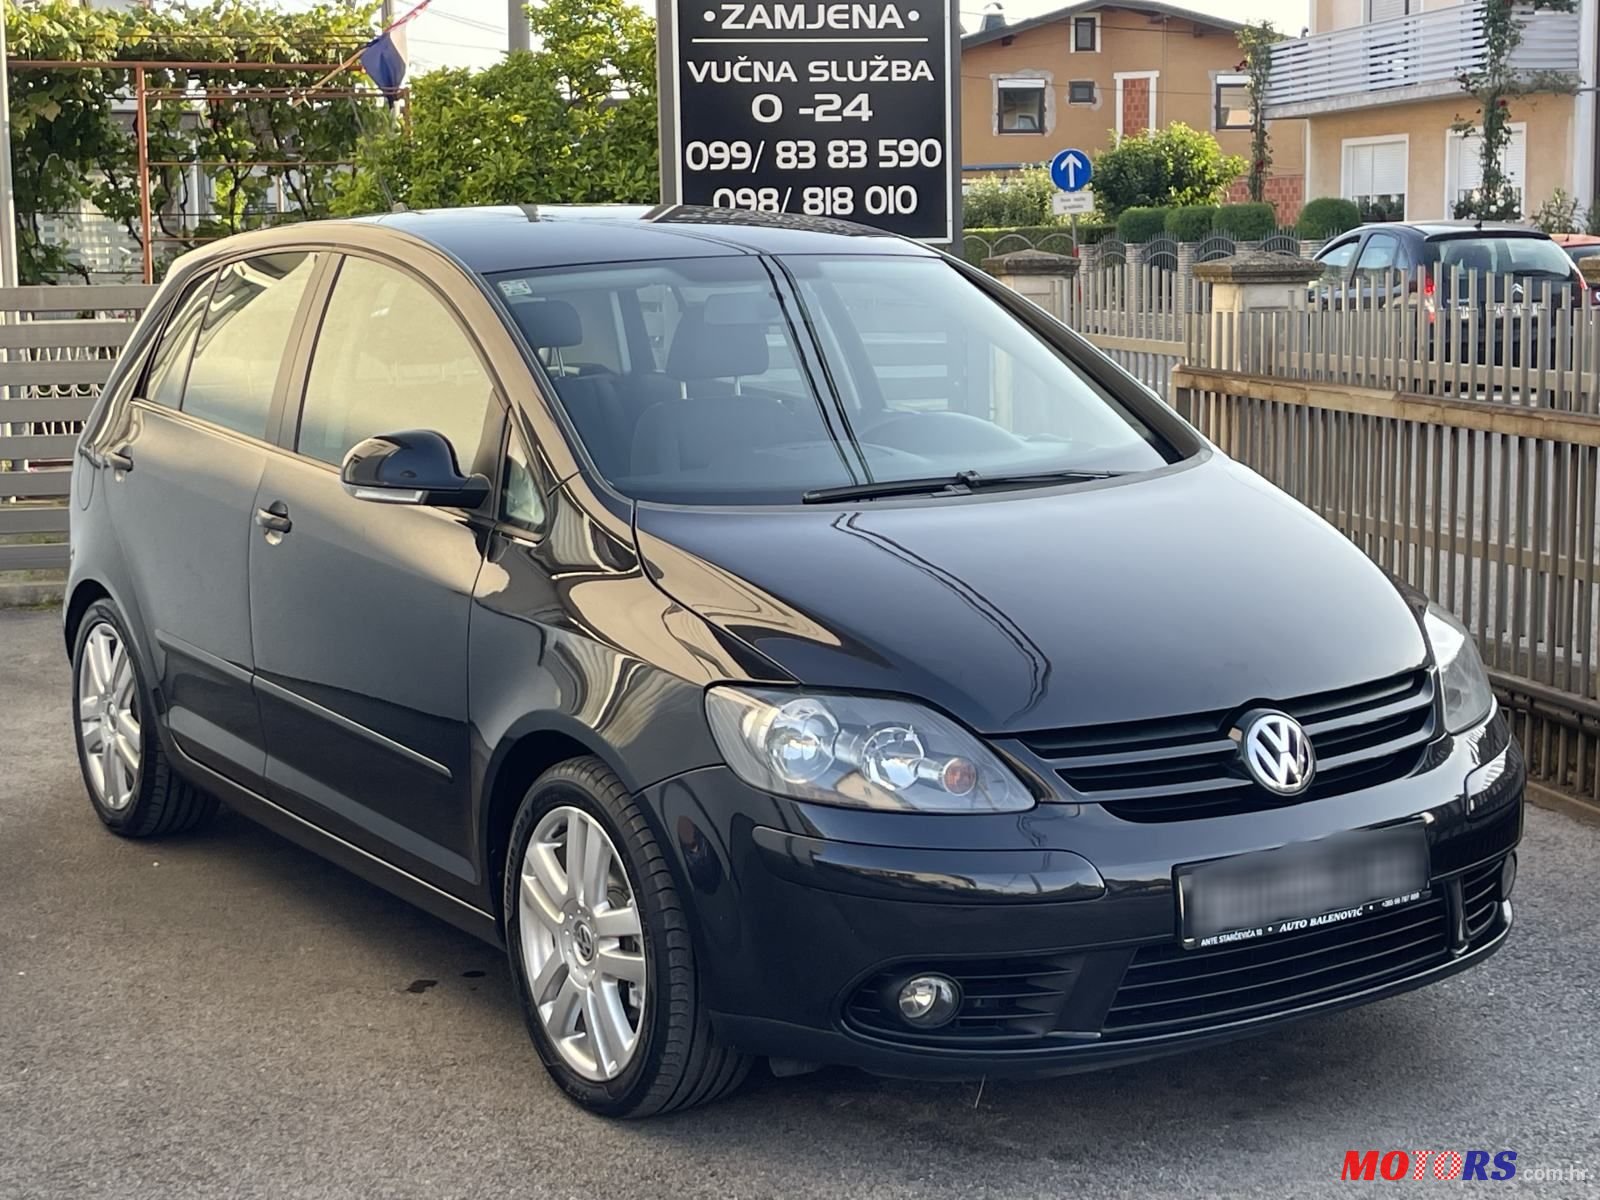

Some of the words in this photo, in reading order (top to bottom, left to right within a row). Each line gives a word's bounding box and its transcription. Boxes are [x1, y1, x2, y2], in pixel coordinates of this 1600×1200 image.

[721, 4, 905, 30] ZAMJENA
[687, 55, 798, 83] VUČNA
[808, 54, 935, 82] SLUŽBA
[685, 140, 765, 173] 099/
[775, 140, 817, 170] 83
[827, 139, 868, 169] 83
[878, 138, 942, 168] 590
[713, 187, 793, 214] 098/
[802, 186, 855, 215] 818
[864, 185, 918, 214] 010
[1279, 918, 1308, 933] AUTO
[1310, 904, 1364, 927] BALENOVIĆ
